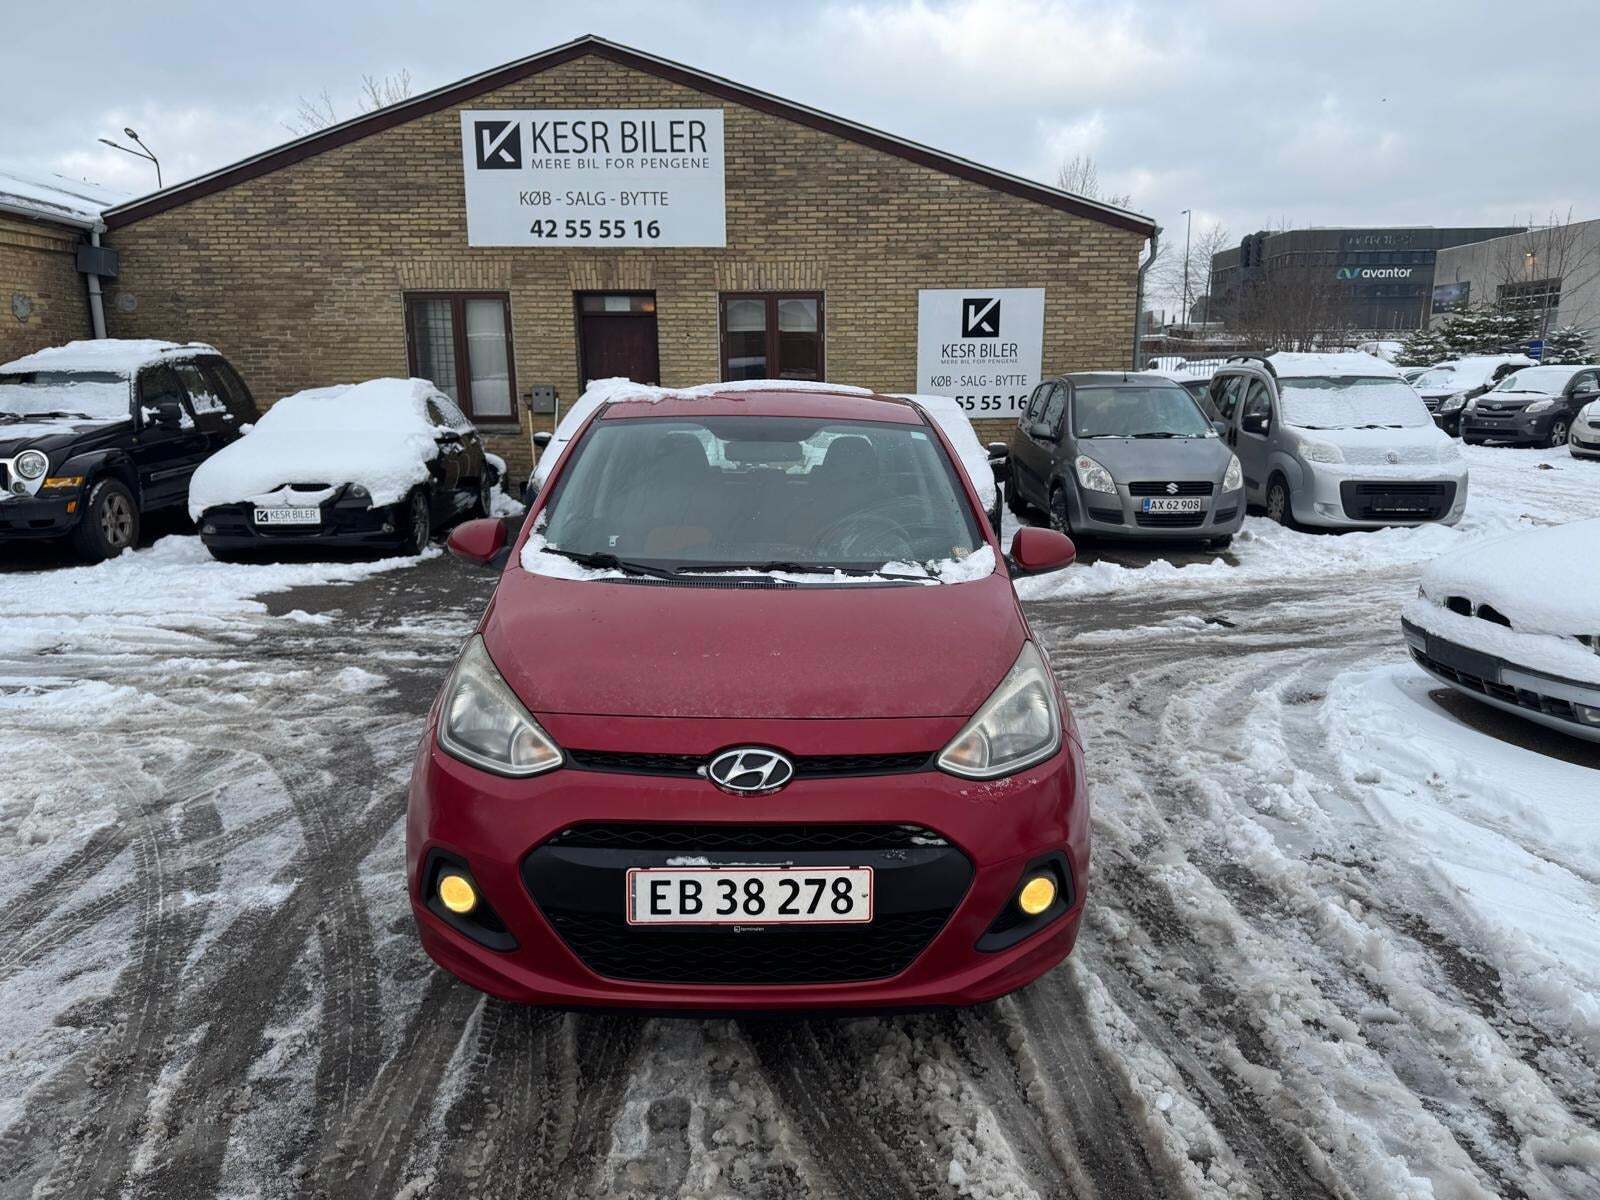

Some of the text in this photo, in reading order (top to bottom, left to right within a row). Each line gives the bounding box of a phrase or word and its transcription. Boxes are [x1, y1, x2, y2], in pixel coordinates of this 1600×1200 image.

[532, 120, 707, 153] KESR BILER
[532, 158, 710, 169] MERE BIL FOR PENGENE
[519, 192, 551, 206] KØB
[565, 191, 606, 206] SALG
[620, 191, 669, 206] BYTTE
[530, 219, 660, 238] 42 55 55 16
[1362, 267, 1412, 278] avantor
[942, 343, 1018, 358] KESR BILER
[931, 375, 952, 387] KØB
[960, 375, 986, 387] SALG
[996, 375, 1027, 386] BYTTE
[980, 395, 1002, 410] 55
[1008, 395, 1028, 410] 16
[1151, 500, 1199, 510] AX 62 908
[271, 511, 290, 519] KESR
[293, 510, 316, 519] BILER
[650, 877, 854, 916] EB 38 278
